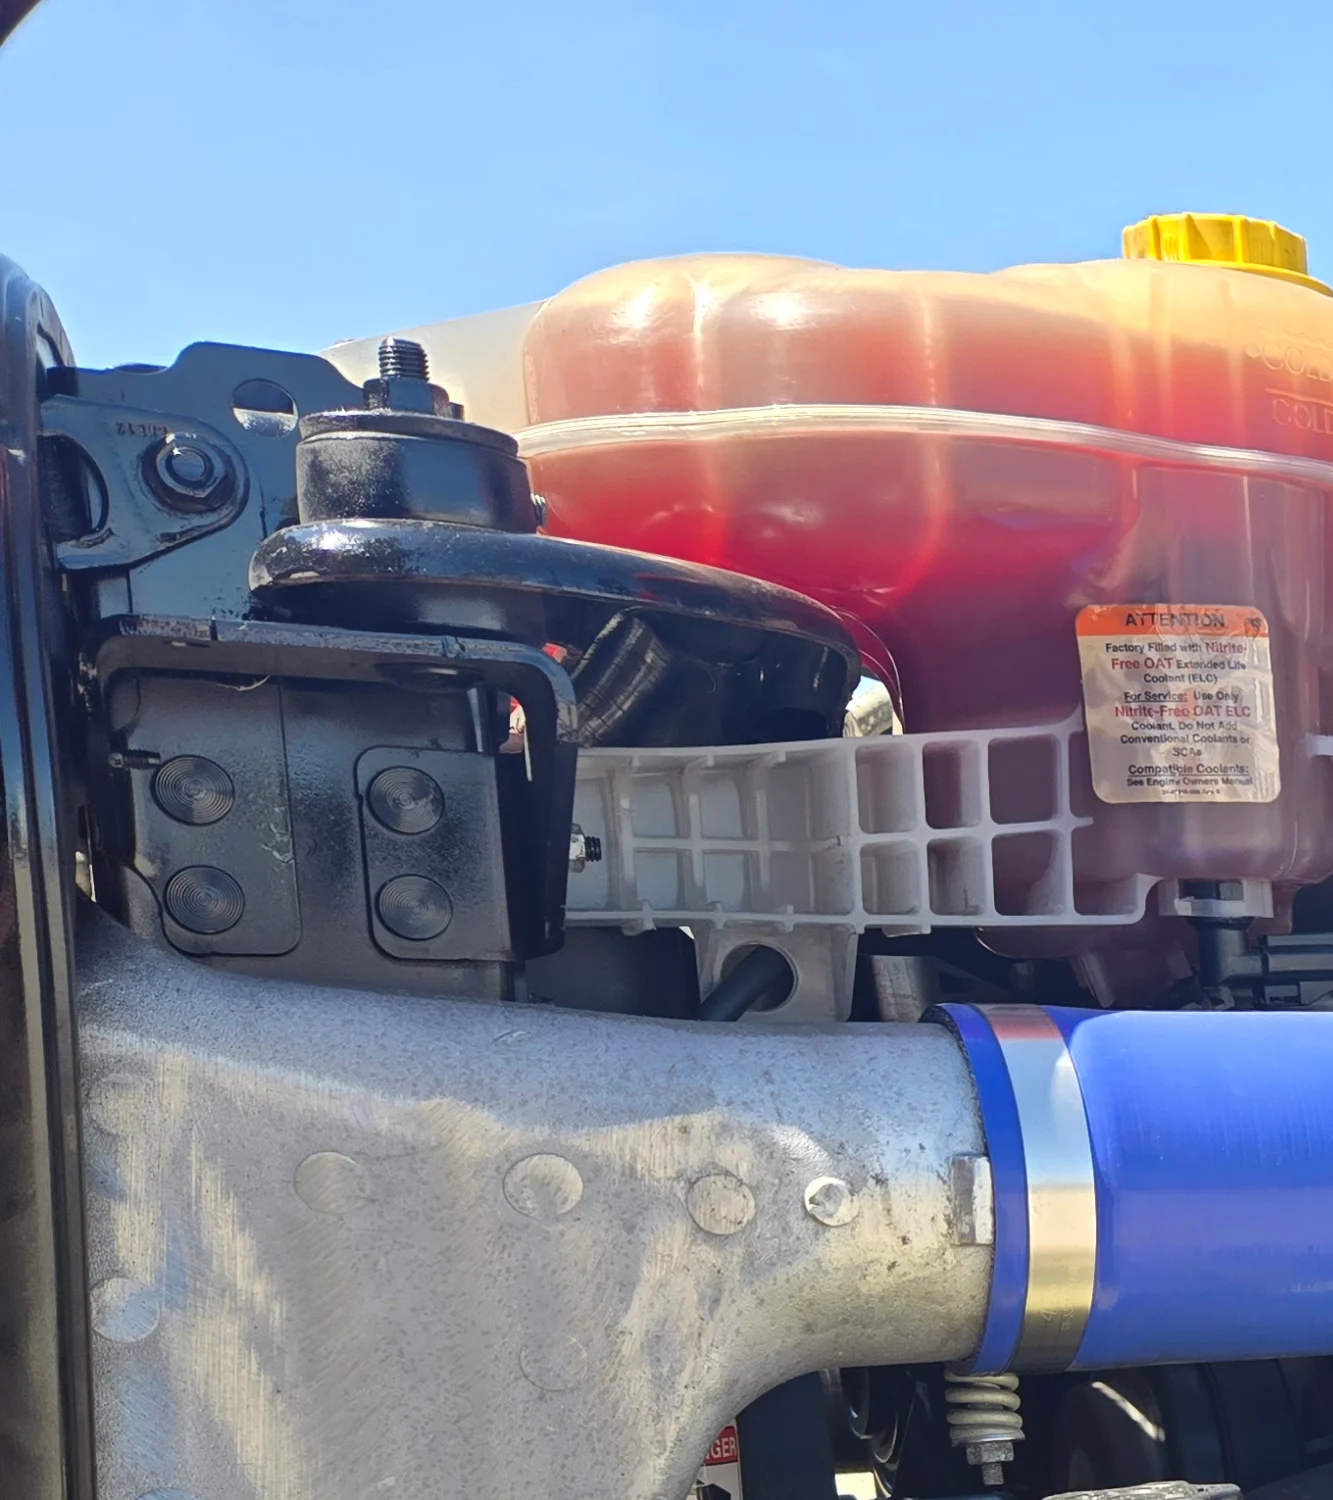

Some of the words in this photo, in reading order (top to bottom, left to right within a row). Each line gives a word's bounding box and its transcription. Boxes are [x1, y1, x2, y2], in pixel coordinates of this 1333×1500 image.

[1125, 612, 1225, 628] ATTENTION
[1105, 642, 1144, 654] Factory
[1148, 642, 1177, 653] Filled
[1179, 643, 1201, 653] with
[1205, 641, 1248, 654] Nitrite-
[1111, 658, 1141, 670] Free
[1143, 657, 1174, 670] OAT
[1176, 658, 1226, 670] Extended
[1227, 658, 1246, 670] Life
[1143, 673, 1186, 684] Coolant
[1188, 673, 1218, 685] (ELC)
[1124, 691, 1142, 702] For
[1144, 691, 1188, 702] Service:
[1193, 691, 1213, 701] Use
[1216, 691, 1239, 704] Only
[1115, 705, 1190, 718] Nitrite-Free
[1193, 705, 1222, 718] OAT
[1226, 705, 1252, 717] ELC
[1179, 721, 1194, 731] Do
[1196, 721, 1215, 731] Not
[1218, 720, 1238, 731] Add
[1120, 734, 1190, 744] Conventional
[1192, 734, 1238, 744] Coolants
[1240, 736, 1250, 744] or
[1127, 777, 1144, 787] See
[704, 1436, 738, 1459] GER
